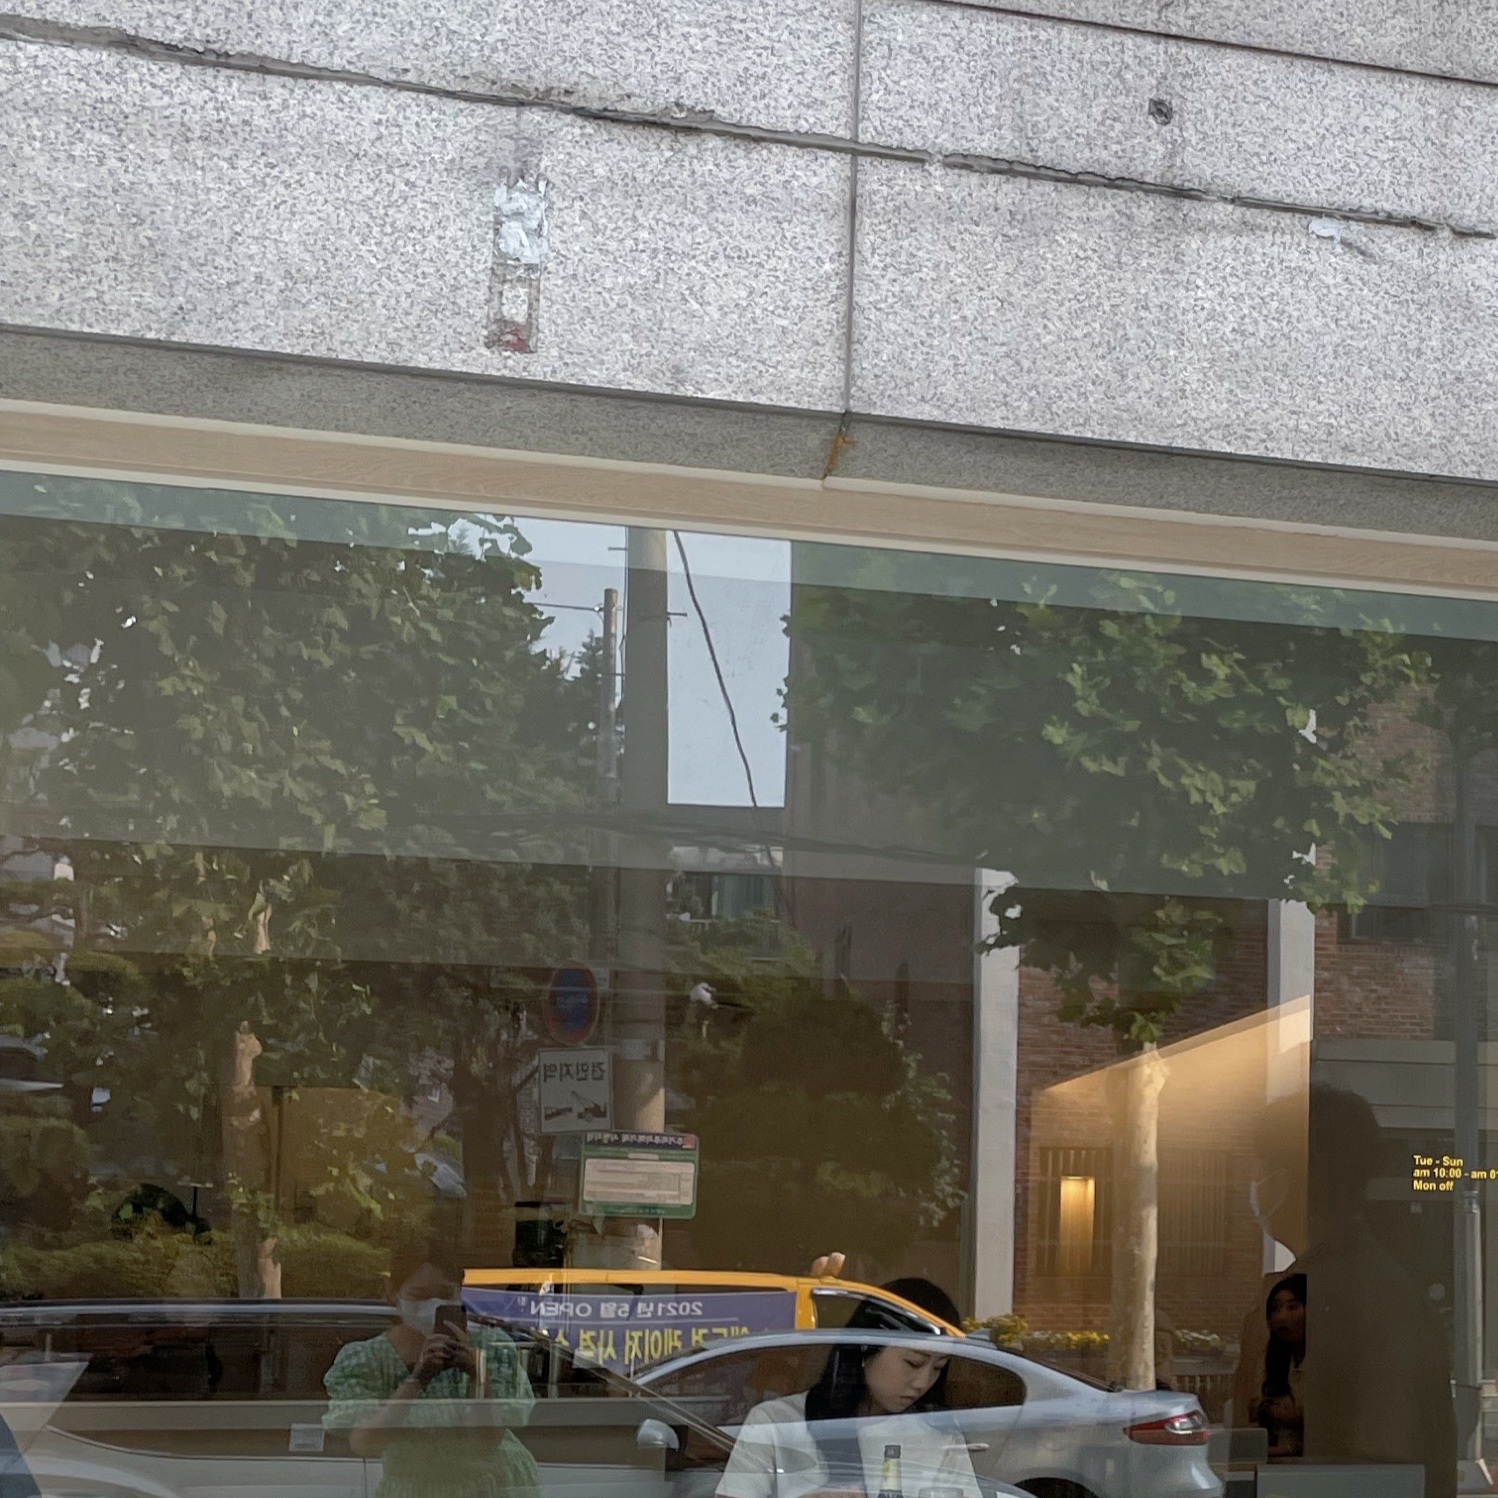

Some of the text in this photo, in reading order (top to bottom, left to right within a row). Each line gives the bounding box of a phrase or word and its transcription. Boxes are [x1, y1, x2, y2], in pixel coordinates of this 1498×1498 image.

[1413, 1155, 1433, 1166] Tue
[1442, 1156, 1464, 1167] Sun
[1413, 1169, 1430, 1178] am
[1433, 1168, 1462, 1179] 10:00
[1471, 1171, 1487, 1179] am
[1413, 1180, 1454, 1191] Mon off
